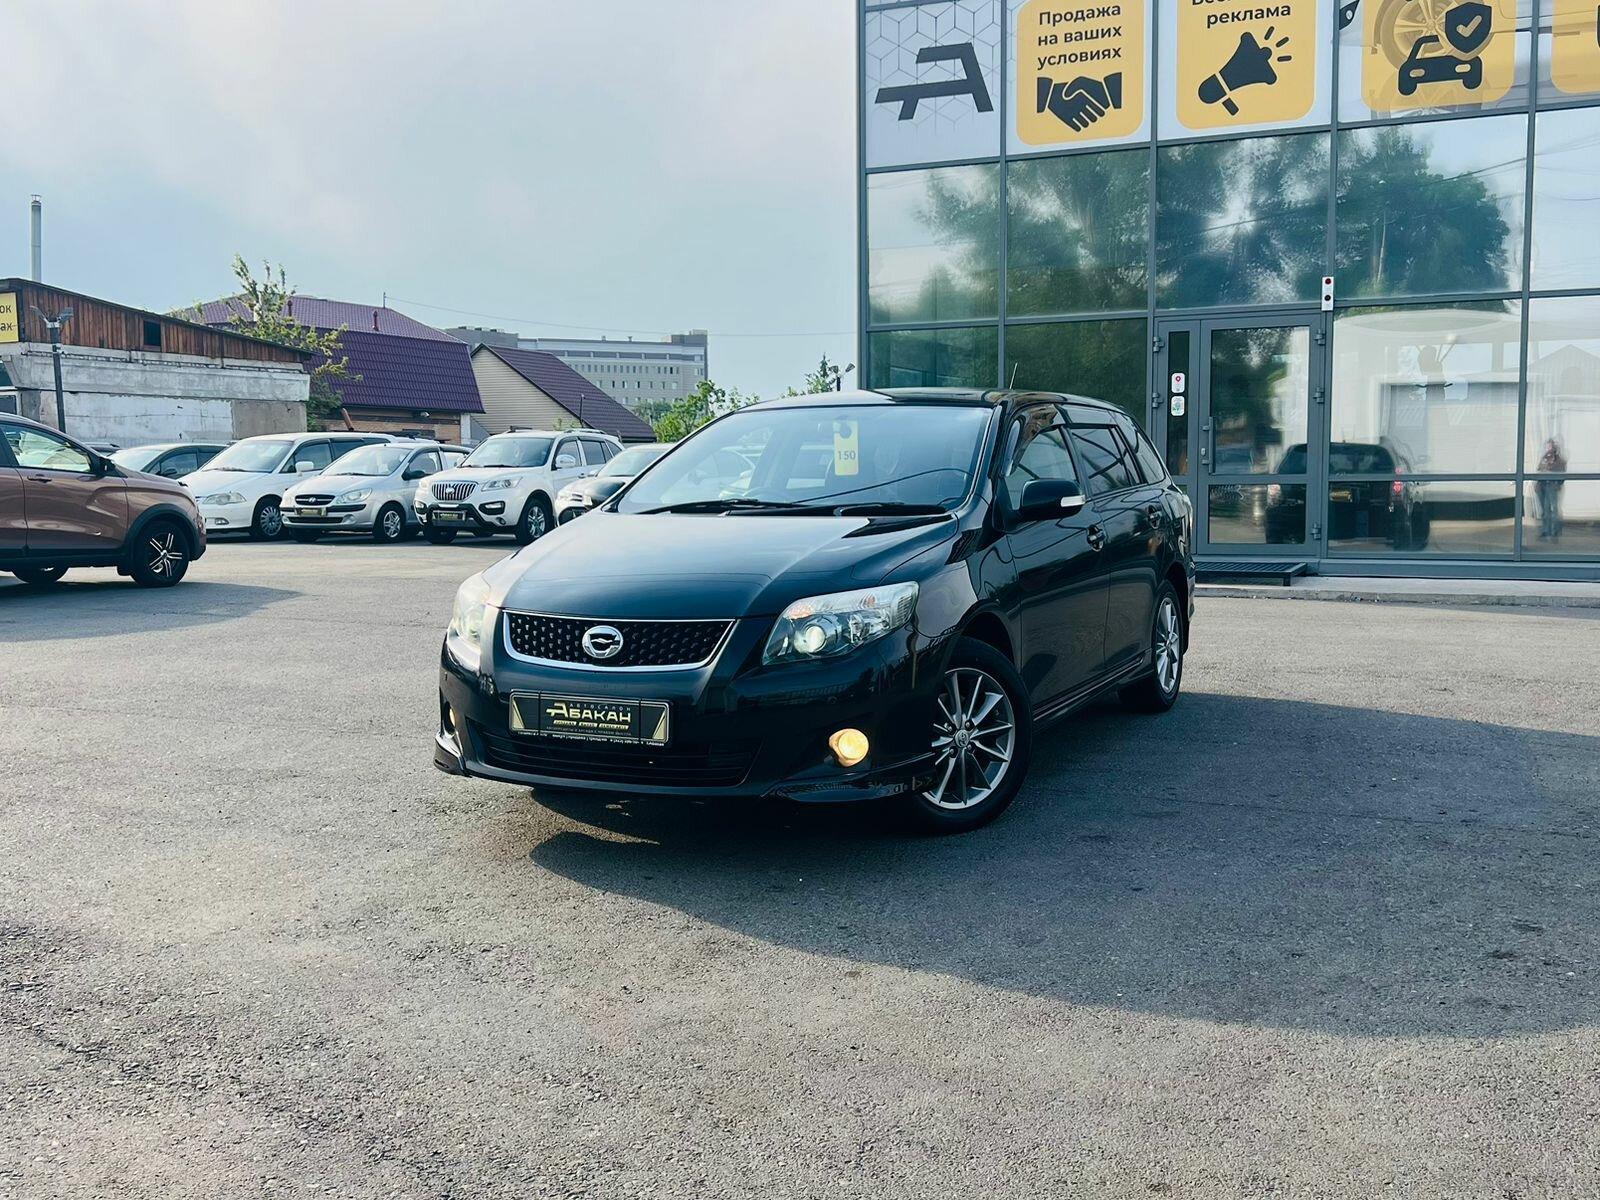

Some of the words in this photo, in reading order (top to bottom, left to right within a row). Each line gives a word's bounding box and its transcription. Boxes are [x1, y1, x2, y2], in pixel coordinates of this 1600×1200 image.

[1039, 5, 1121, 26] Продажа
[1206, 5, 1291, 28] реклама
[1038, 34, 1058, 46] на
[1064, 26, 1122, 43] ваших
[1037, 47, 1122, 70] условиях
[838, 450, 856, 460] 150
